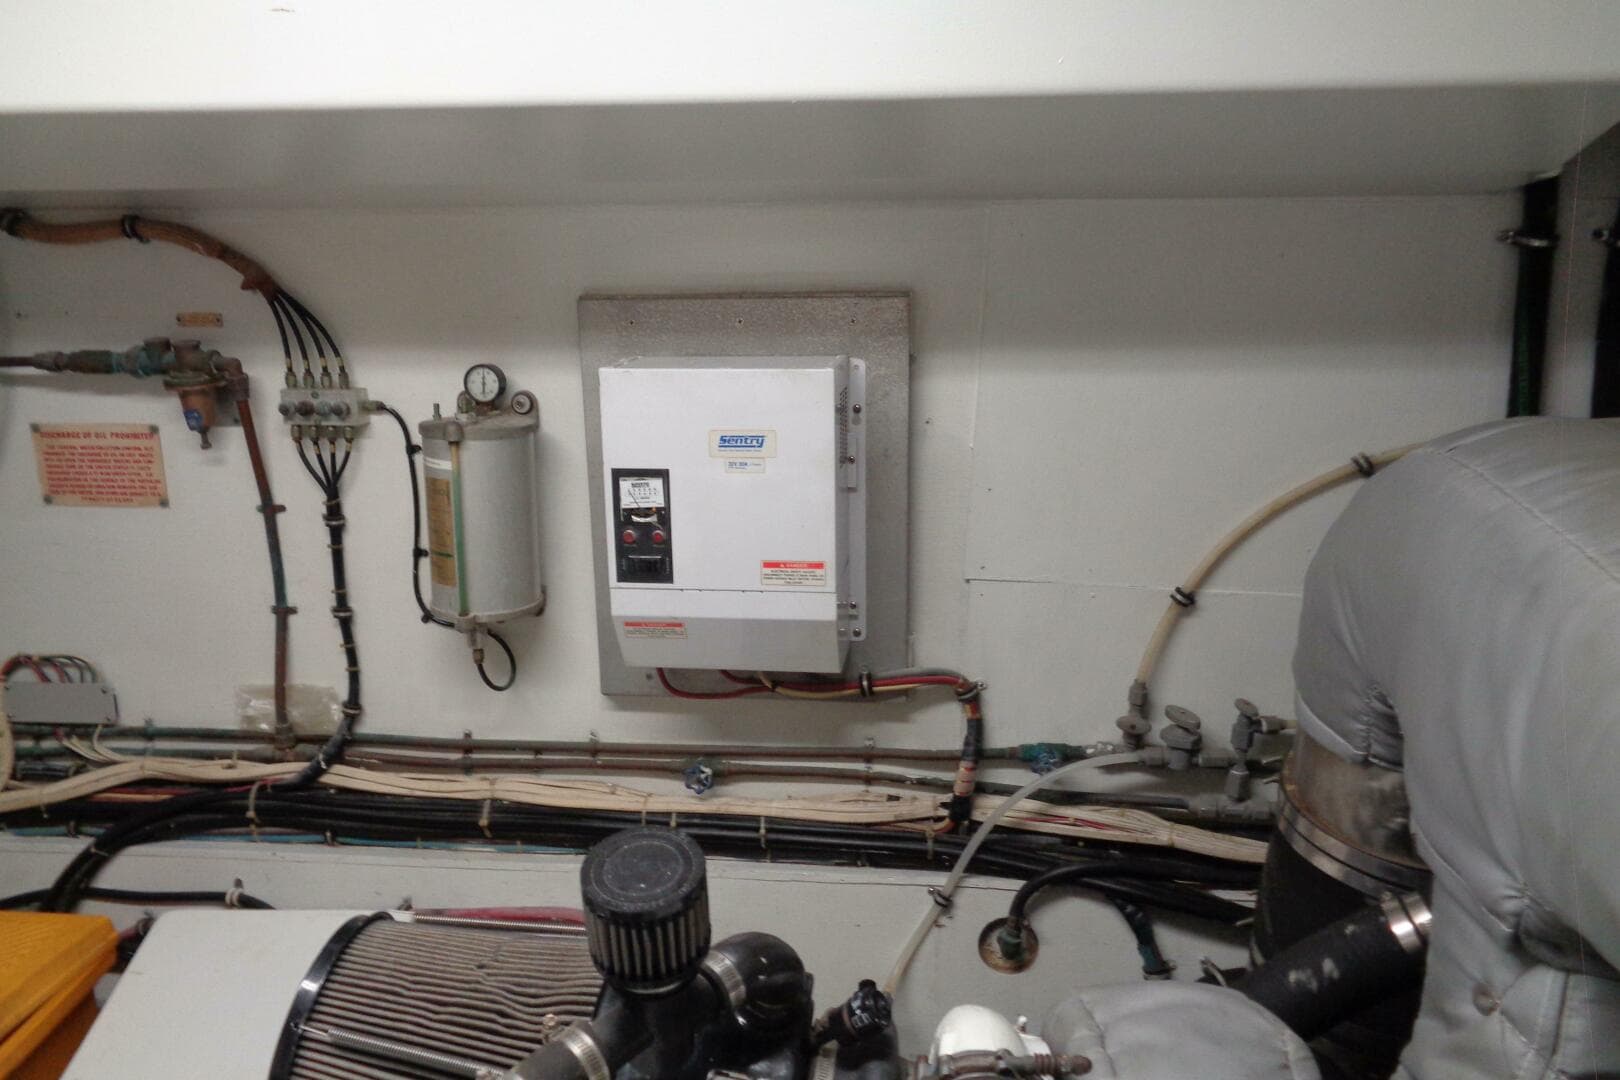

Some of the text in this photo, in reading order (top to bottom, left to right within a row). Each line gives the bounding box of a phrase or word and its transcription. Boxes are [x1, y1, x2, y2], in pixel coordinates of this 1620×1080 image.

[95, 432, 106, 440] OIL
[110, 432, 155, 440] PROHIBITED
[718, 435, 766, 449] Sentry
